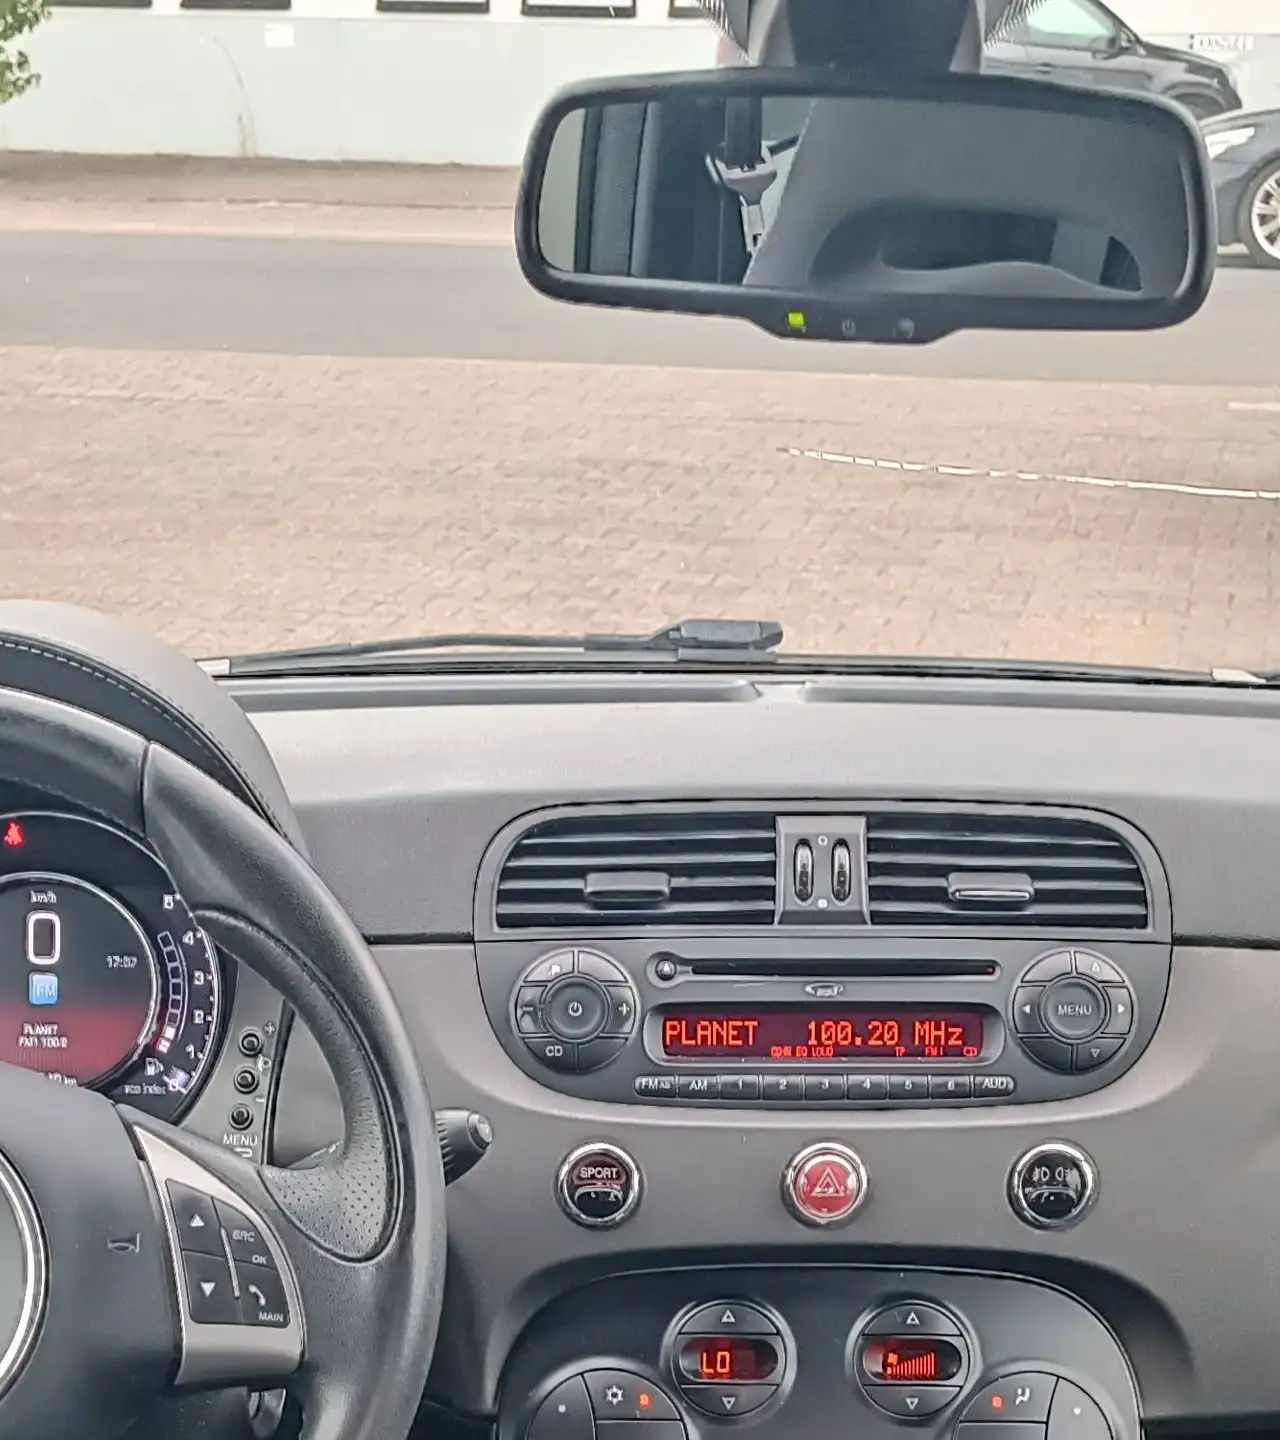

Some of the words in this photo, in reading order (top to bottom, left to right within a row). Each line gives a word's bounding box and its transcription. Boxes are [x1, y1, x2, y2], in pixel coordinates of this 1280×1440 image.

[25, 909, 62, 966] 0
[182, 930, 194, 945] 4
[35, 982, 57, 998] FM
[1057, 1004, 1092, 1016] MENU
[665, 1020, 759, 1046] PLANET
[808, 1020, 899, 1046] 100.20
[914, 1020, 963, 1046] MHz
[545, 1045, 563, 1057] CD
[641, 1078, 659, 1090] FM
[688, 1078, 708, 1091] AM
[778, 1078, 787, 1091] 2
[821, 1078, 830, 1090] 3
[862, 1077, 871, 1090] 4
[904, 1078, 913, 1091] 5
[222, 1133, 258, 1147] MENU
[580, 1166, 618, 1179] SPORT
[251, 1253, 268, 1265] OK
[258, 1311, 284, 1322] MAIN
